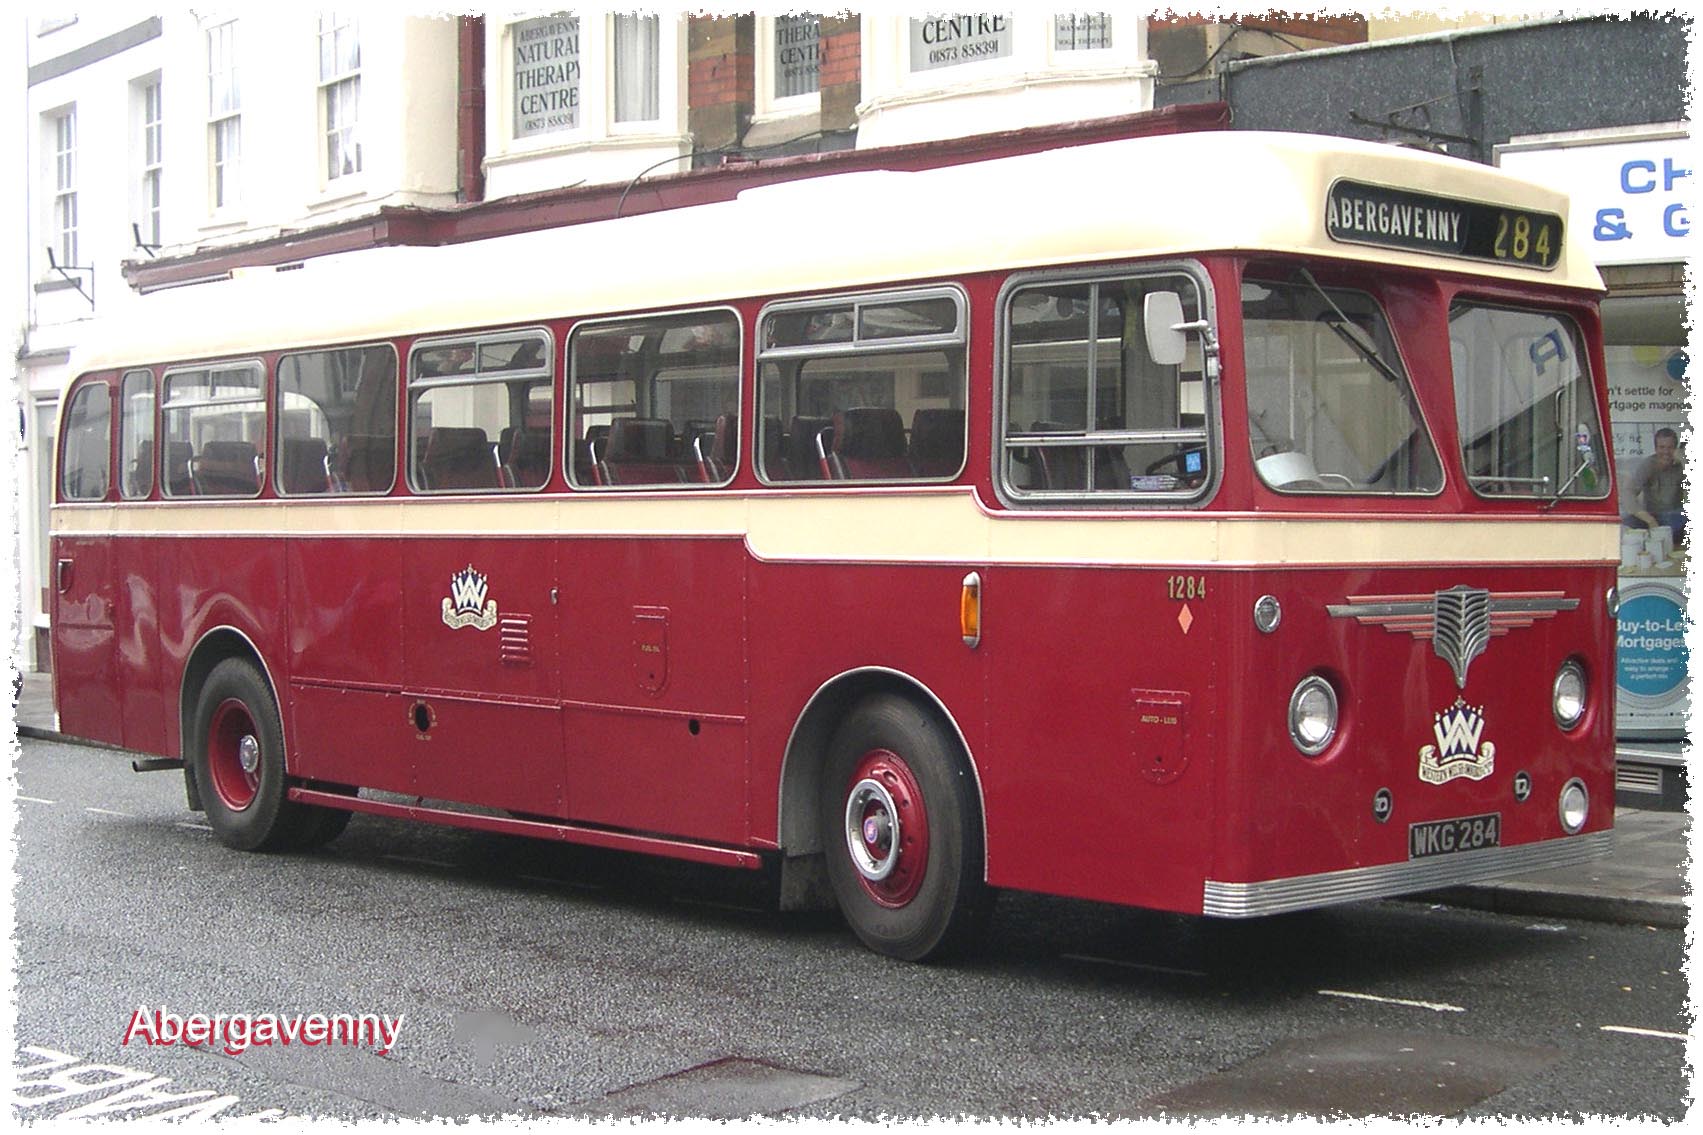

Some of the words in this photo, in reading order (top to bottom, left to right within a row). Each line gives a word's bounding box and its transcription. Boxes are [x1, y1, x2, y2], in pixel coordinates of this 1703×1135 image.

[922, 14, 1006, 45] CENTRE
[517, 34, 580, 64] NATURAL
[929, 47, 958, 64] 01873
[961, 39, 999, 58] 858391
[516, 60, 580, 90] THERAPY
[521, 87, 579, 115] CENTRE
[1328, 197, 1460, 243] ABERGAVENNY
[1494, 215, 1550, 265] 284
[1593, 208, 1633, 241] &
[1625, 386, 1656, 396] settle
[1658, 385, 1674, 396] for
[1168, 576, 1206, 599] 1284
[1414, 824, 1455, 856] WKG
[1459, 817, 1496, 849] 284
